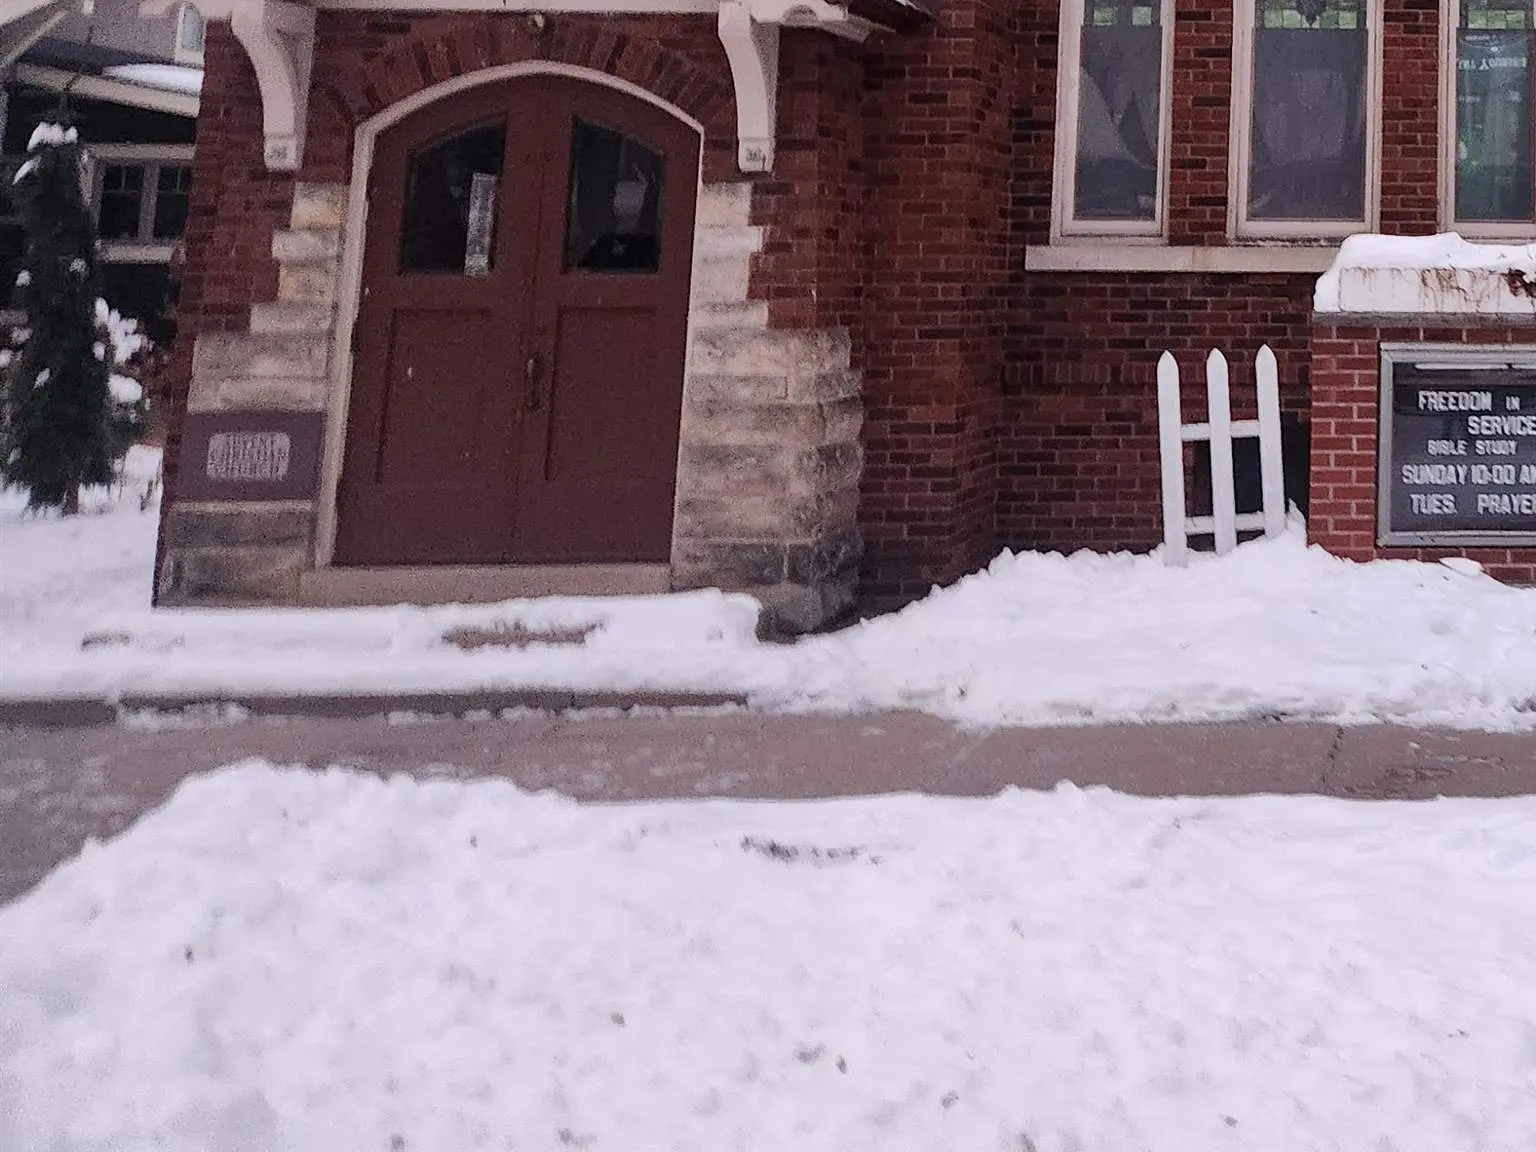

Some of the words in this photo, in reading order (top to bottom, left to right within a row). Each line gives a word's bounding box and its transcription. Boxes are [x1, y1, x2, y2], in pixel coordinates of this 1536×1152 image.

[1418, 391, 1493, 412] FREEDOM
[1505, 396, 1520, 411] IN
[1427, 440, 1467, 456] BIBLE
[1475, 440, 1517, 456] STUDY
[1401, 464, 1467, 485] SUNDAY
[1471, 464, 1516, 485] 10:00
